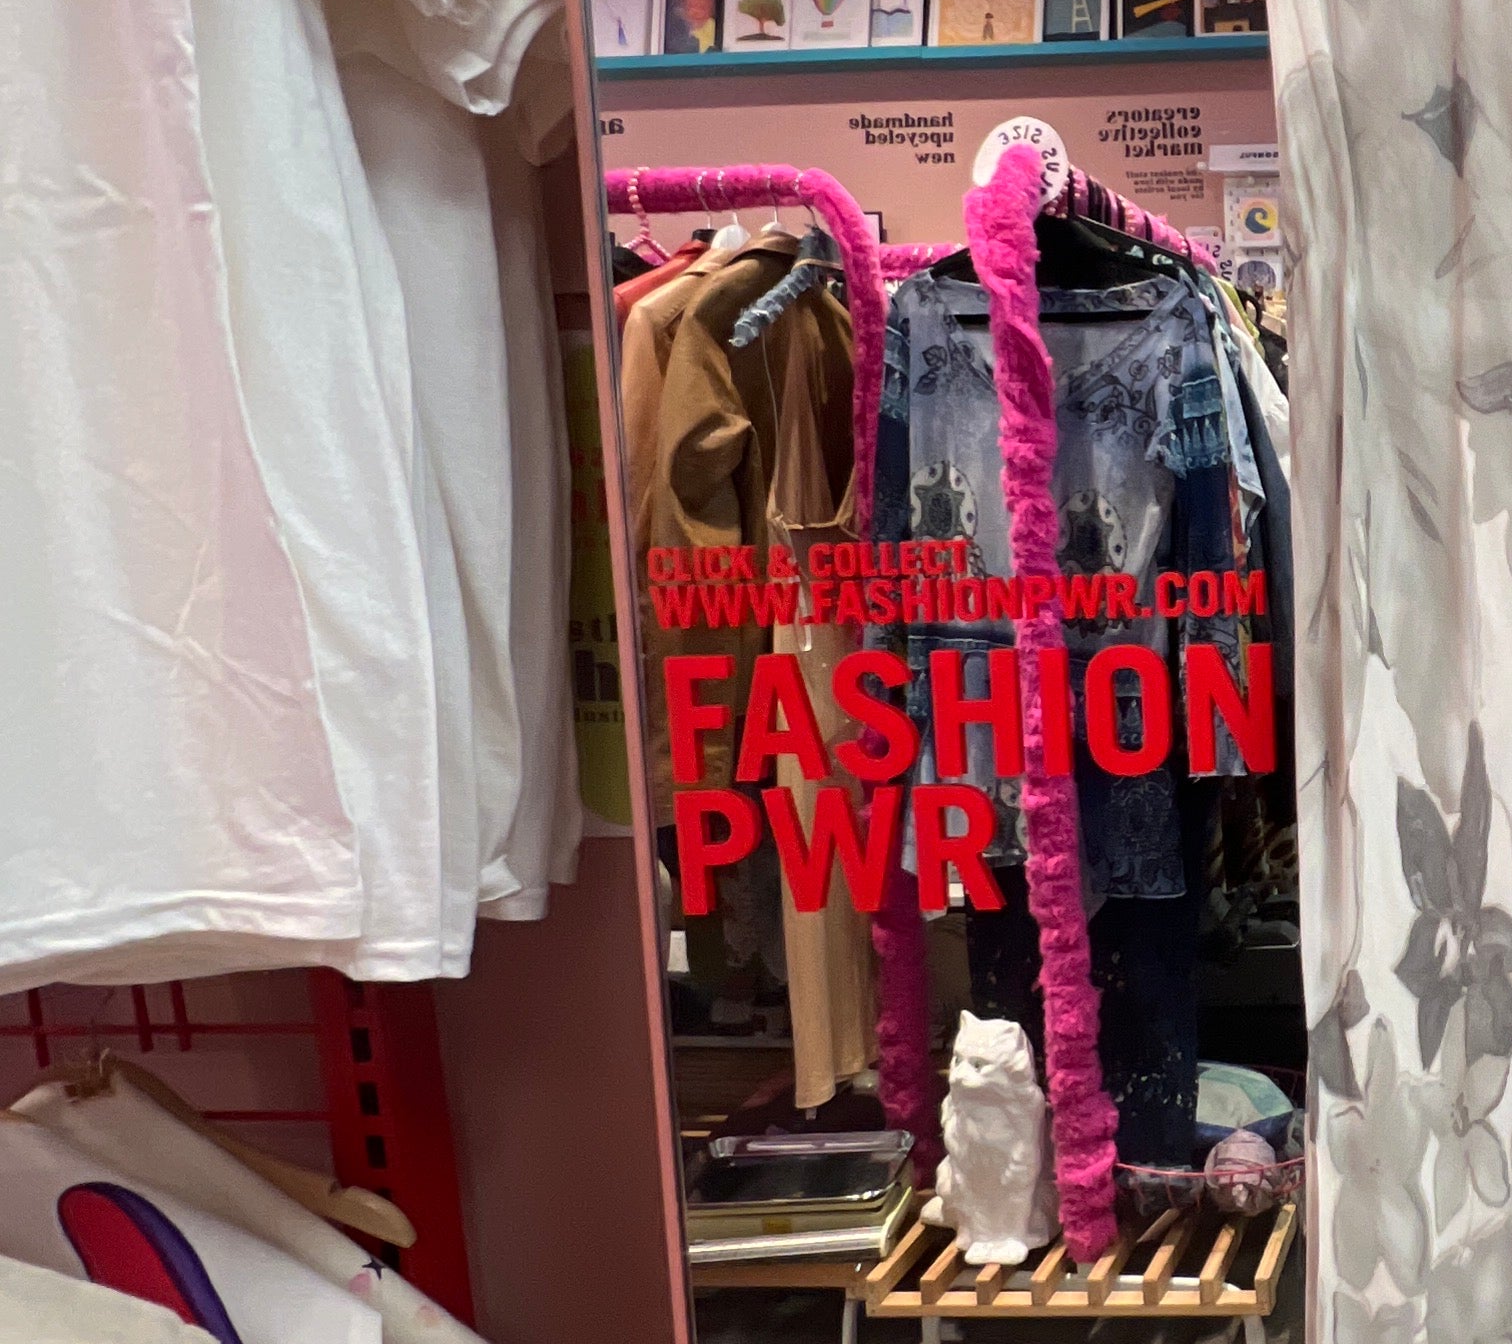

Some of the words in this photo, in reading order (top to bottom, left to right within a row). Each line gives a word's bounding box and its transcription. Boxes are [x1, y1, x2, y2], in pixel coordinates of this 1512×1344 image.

[647, 545, 756, 582] CLICK
[766, 543, 797, 579] &
[808, 539, 972, 578] COLLECT
[649, 570, 1268, 630] WWW.FASHIONPWR.COM
[662, 642, 1280, 784] FASHION
[674, 783, 1007, 916] PWR
